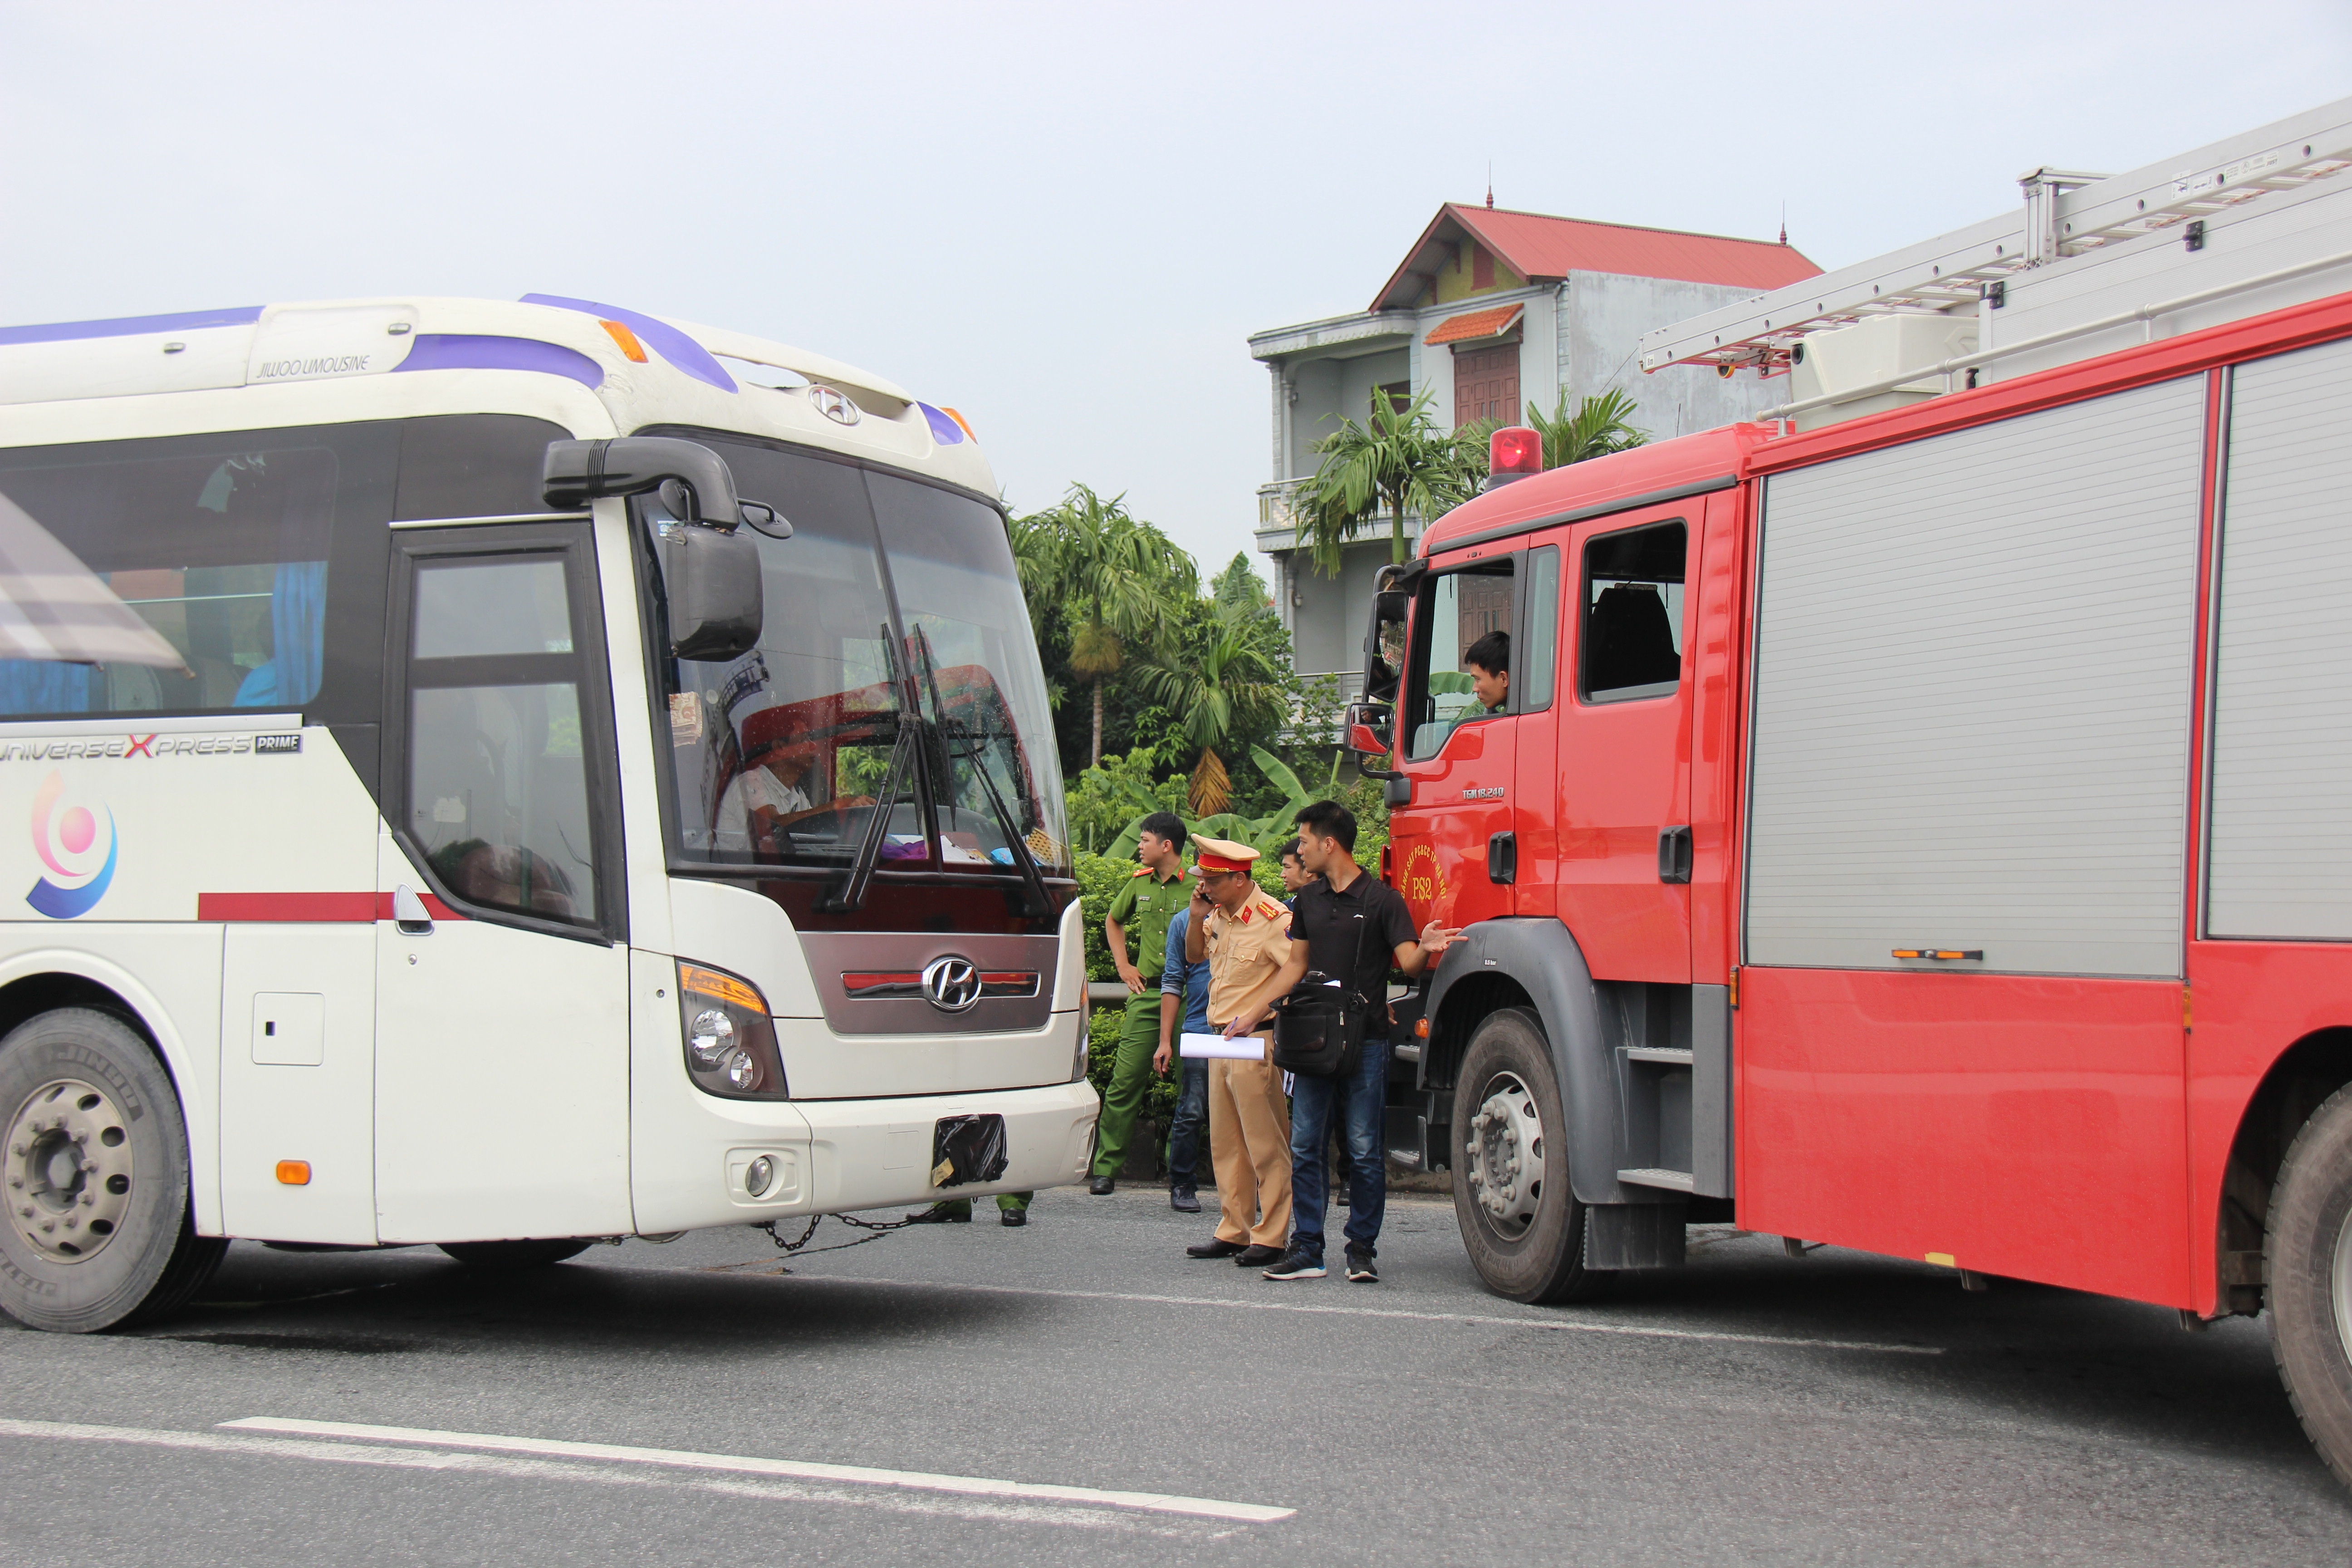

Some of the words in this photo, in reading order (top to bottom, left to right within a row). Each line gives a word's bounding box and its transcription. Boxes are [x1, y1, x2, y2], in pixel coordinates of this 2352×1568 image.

[256, 360, 302, 379] JIWOO
[303, 354, 370, 375] LIMOUSINE
[258, 735, 299, 750] PRIME
[1478, 787, 1504, 799] 18.240
[1414, 844, 1431, 858] PC&CC
[1430, 850, 1437, 864] TP
[1412, 877, 1432, 900] PS2
